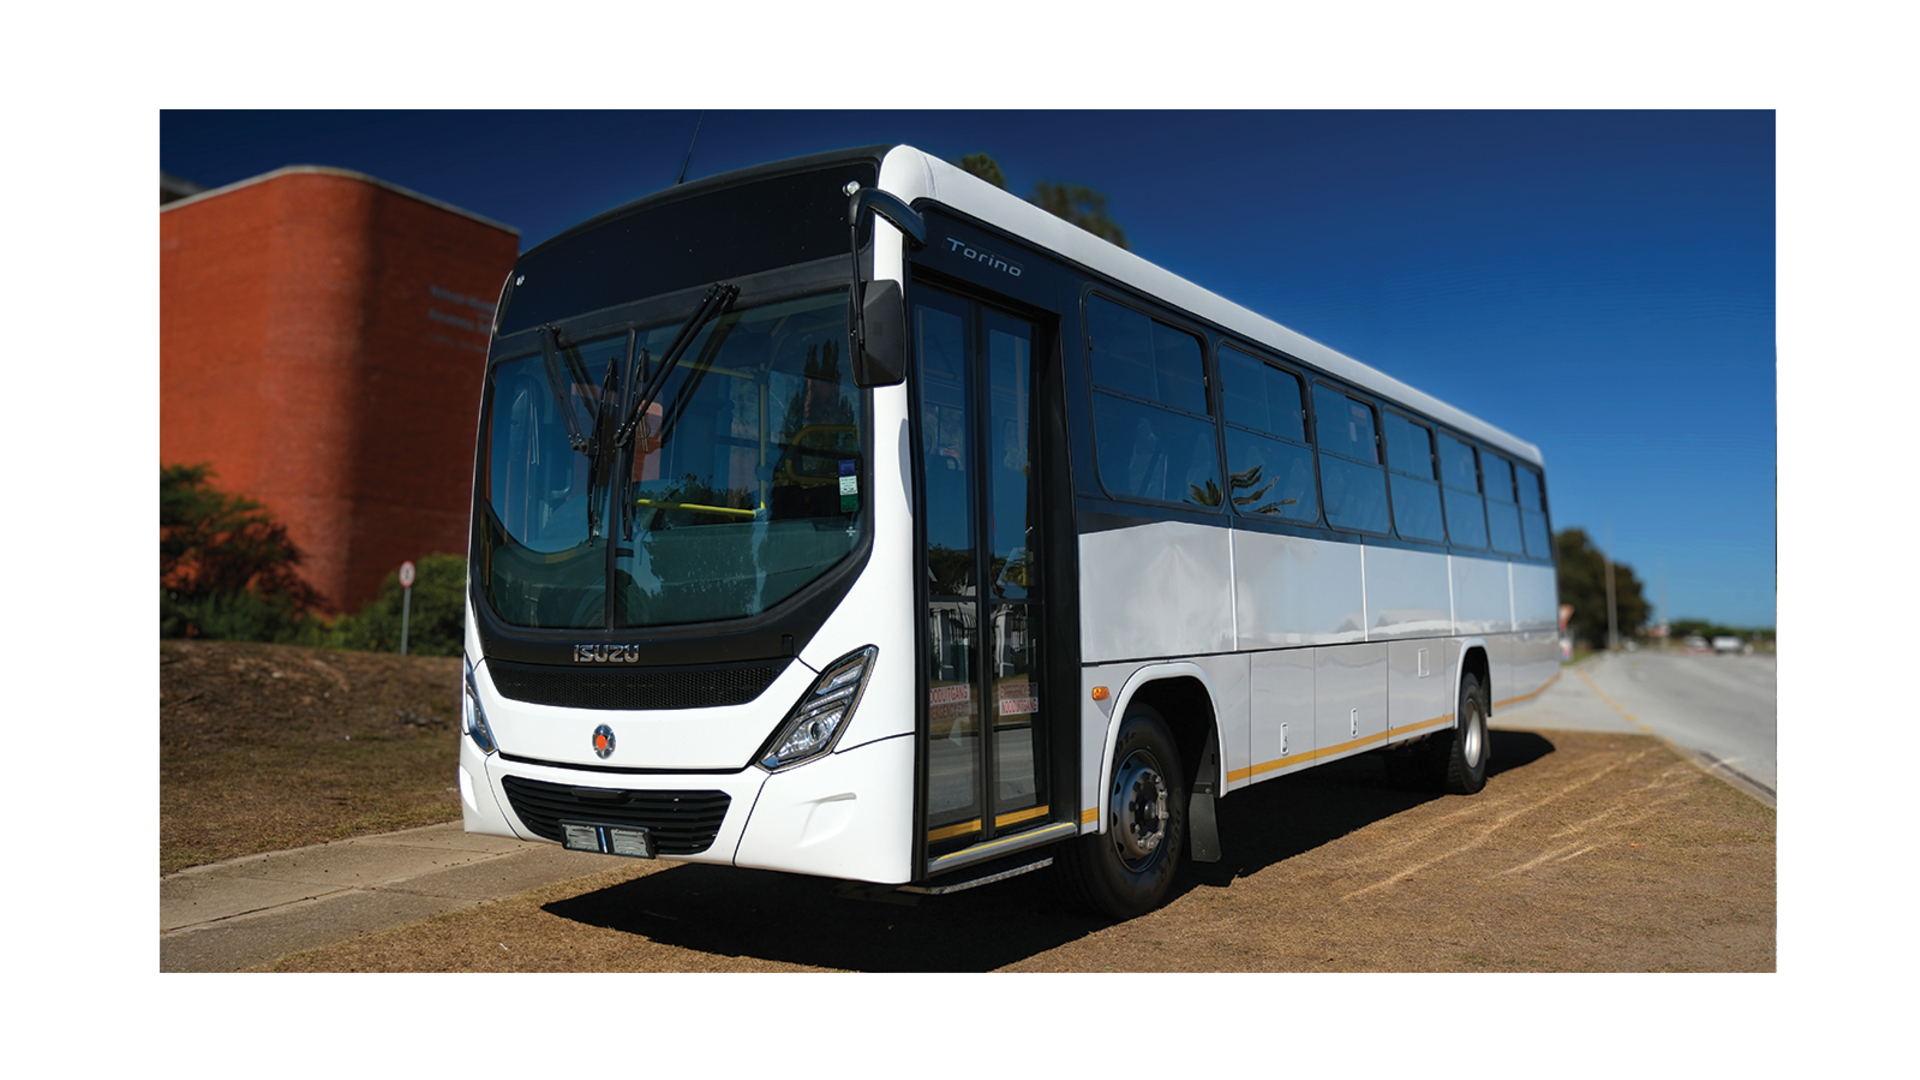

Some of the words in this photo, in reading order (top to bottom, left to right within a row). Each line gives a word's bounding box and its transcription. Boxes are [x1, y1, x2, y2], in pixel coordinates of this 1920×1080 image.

[946, 237, 1021, 277] Torino
[573, 644, 639, 663] ISUZU
[930, 685, 968, 704] OODUITGANG
